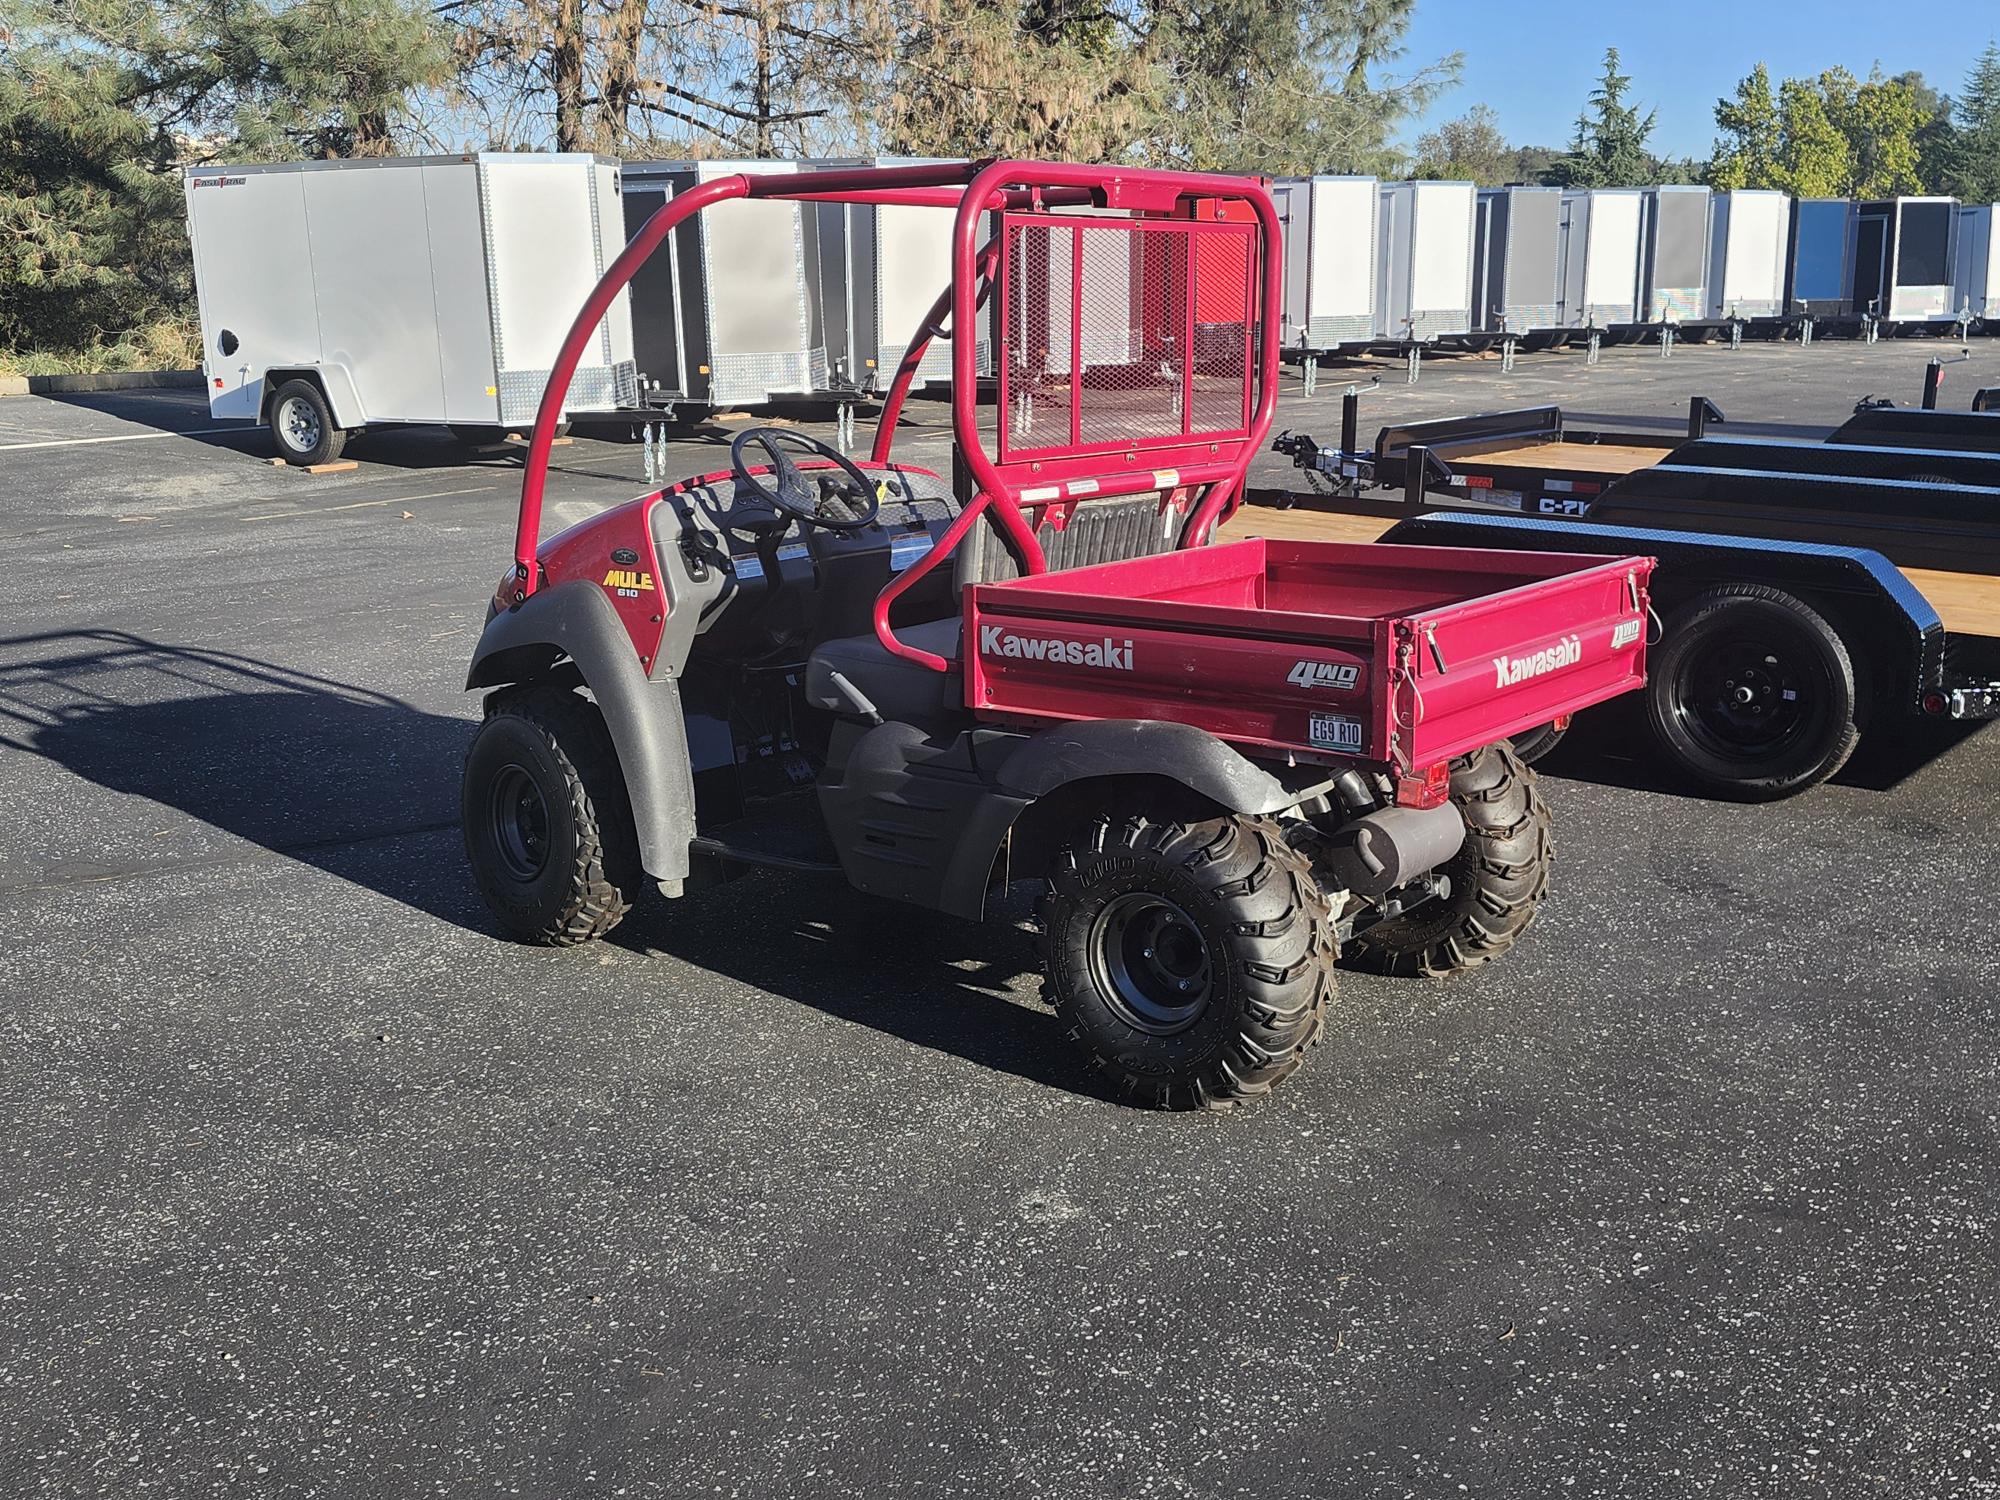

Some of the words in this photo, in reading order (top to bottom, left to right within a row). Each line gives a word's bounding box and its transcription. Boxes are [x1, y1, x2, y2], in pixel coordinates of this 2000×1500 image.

[602, 569, 655, 590] MULE
[617, 588, 639, 598] 610
[1610, 619, 1641, 649] 4WD
[981, 625, 1134, 671] Kawasaki
[1492, 634, 1582, 688] Kawasaki
[1286, 661, 1359, 688] 4WD
[1313, 720, 1335, 741] EG9
[1339, 723, 1359, 744] R10
